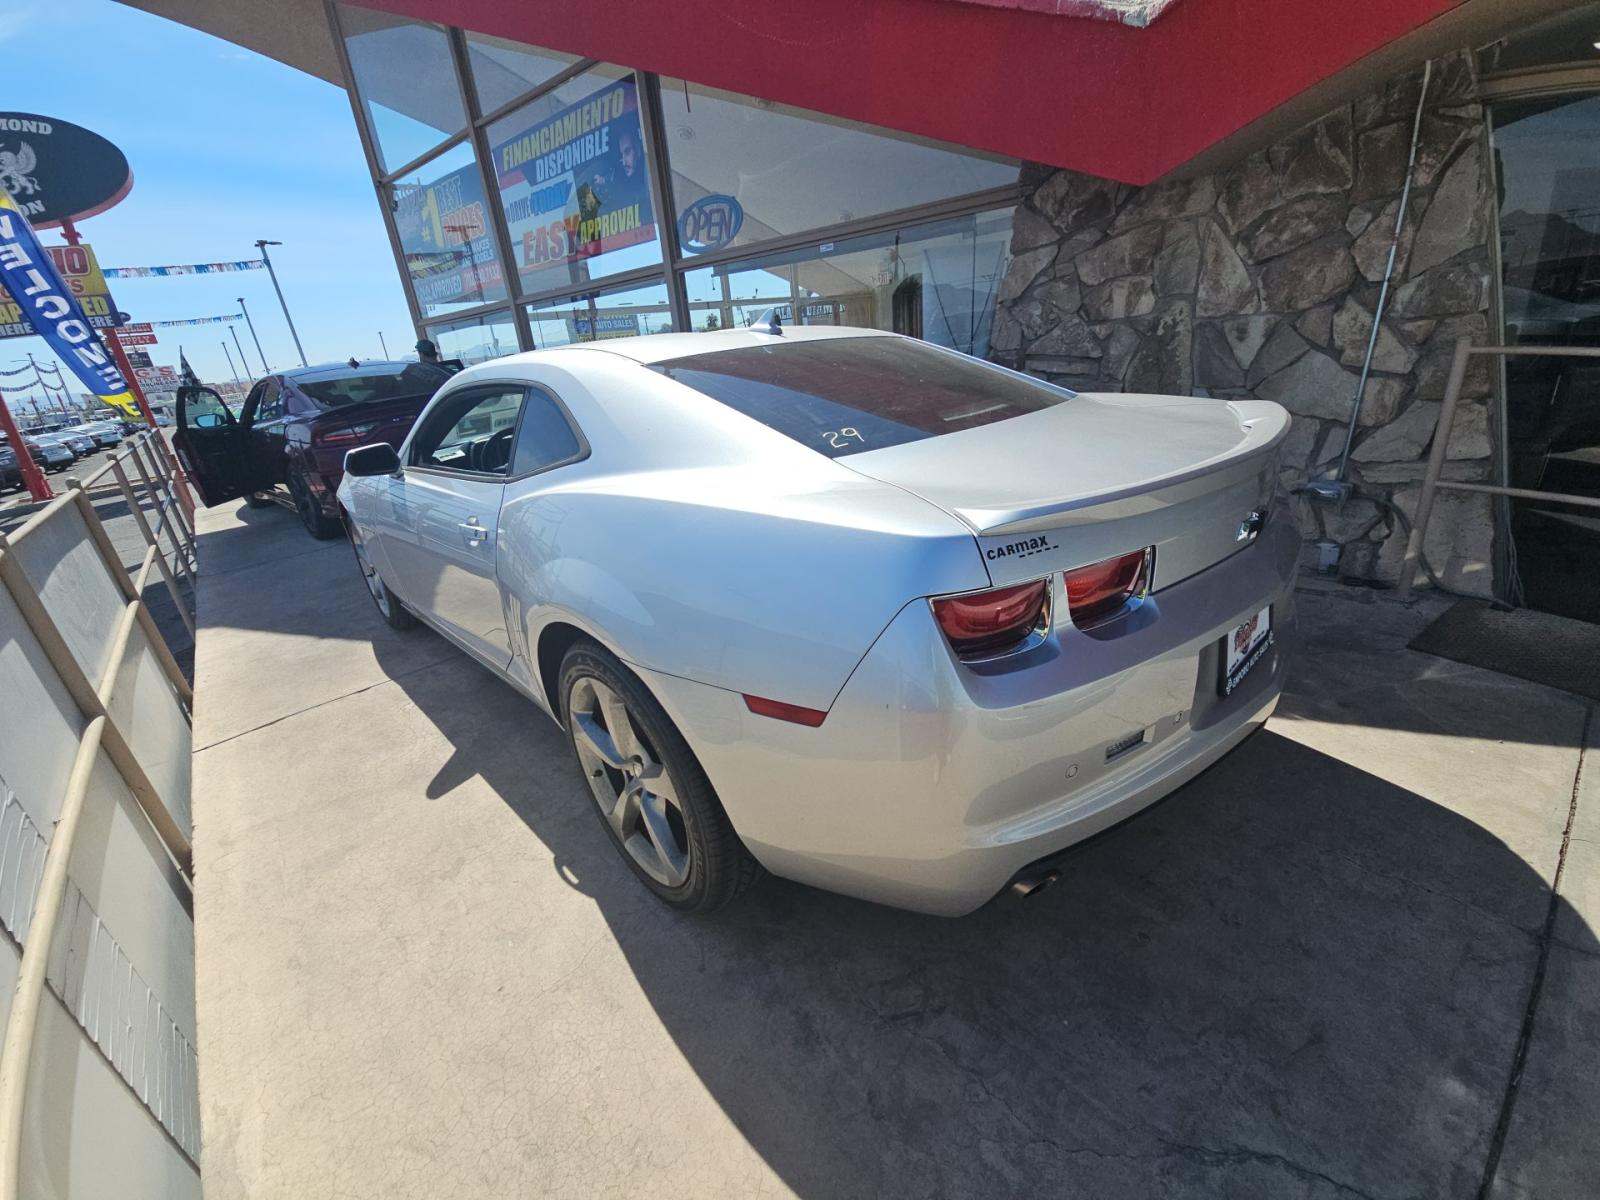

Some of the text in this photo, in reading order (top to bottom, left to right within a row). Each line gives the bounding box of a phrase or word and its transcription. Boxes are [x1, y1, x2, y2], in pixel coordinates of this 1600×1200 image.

[503, 88, 625, 171] FINANCIAMIENTO
[536, 126, 609, 182] DISPONIBLE
[523, 213, 581, 266] EASY
[580, 204, 641, 246] APPROVAL
[682, 207, 732, 243] OPEN
[90, 315, 117, 328] ERE
[822, 427, 865, 448] 29
